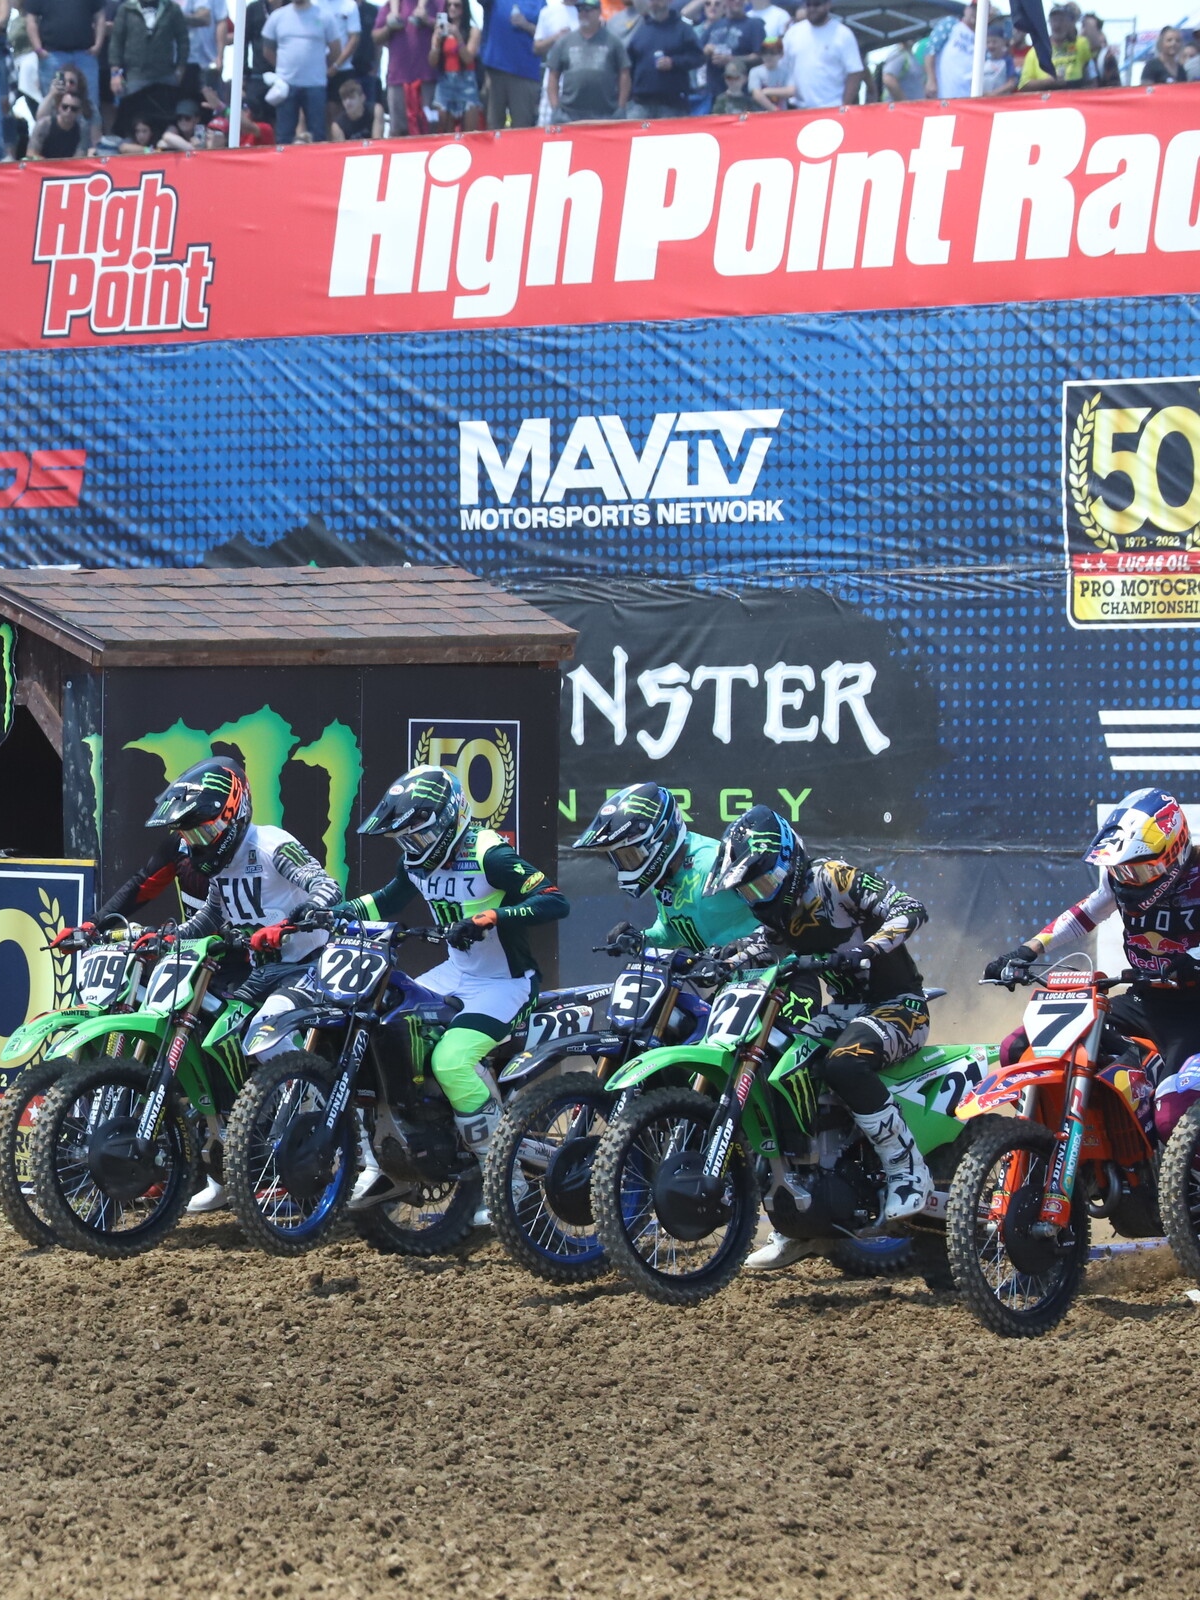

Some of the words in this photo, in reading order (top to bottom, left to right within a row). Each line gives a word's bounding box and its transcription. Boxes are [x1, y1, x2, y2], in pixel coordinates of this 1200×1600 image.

[35, 170, 178, 266] High
[328, 141, 603, 319] High
[613, 114, 964, 283] Point
[42, 246, 215, 339] Point
[1089, 404, 1200, 535] 50
[460, 502, 650, 532] MOTORSPORTS
[657, 498, 785, 526] NETWORK
[1117, 556, 1163, 573] LUCAS
[1166, 555, 1191, 571] OIL
[1080, 581, 1115, 597] PRO
[560, 646, 891, 760] NSTER
[216, 877, 266, 919] FLY
[81, 956, 125, 989] 309
[151, 963, 193, 1003] 7
[321, 949, 382, 993] 28
[534, 1009, 580, 1042] 28
[1031, 1002, 1088, 1048] 7
[143, 1084, 165, 1140] DUNLOP
[326, 1071, 349, 1128] DUNLOP
[711, 1118, 734, 1178] DUNLOP
[1066, 1133, 1083, 1176] MOTOREX
